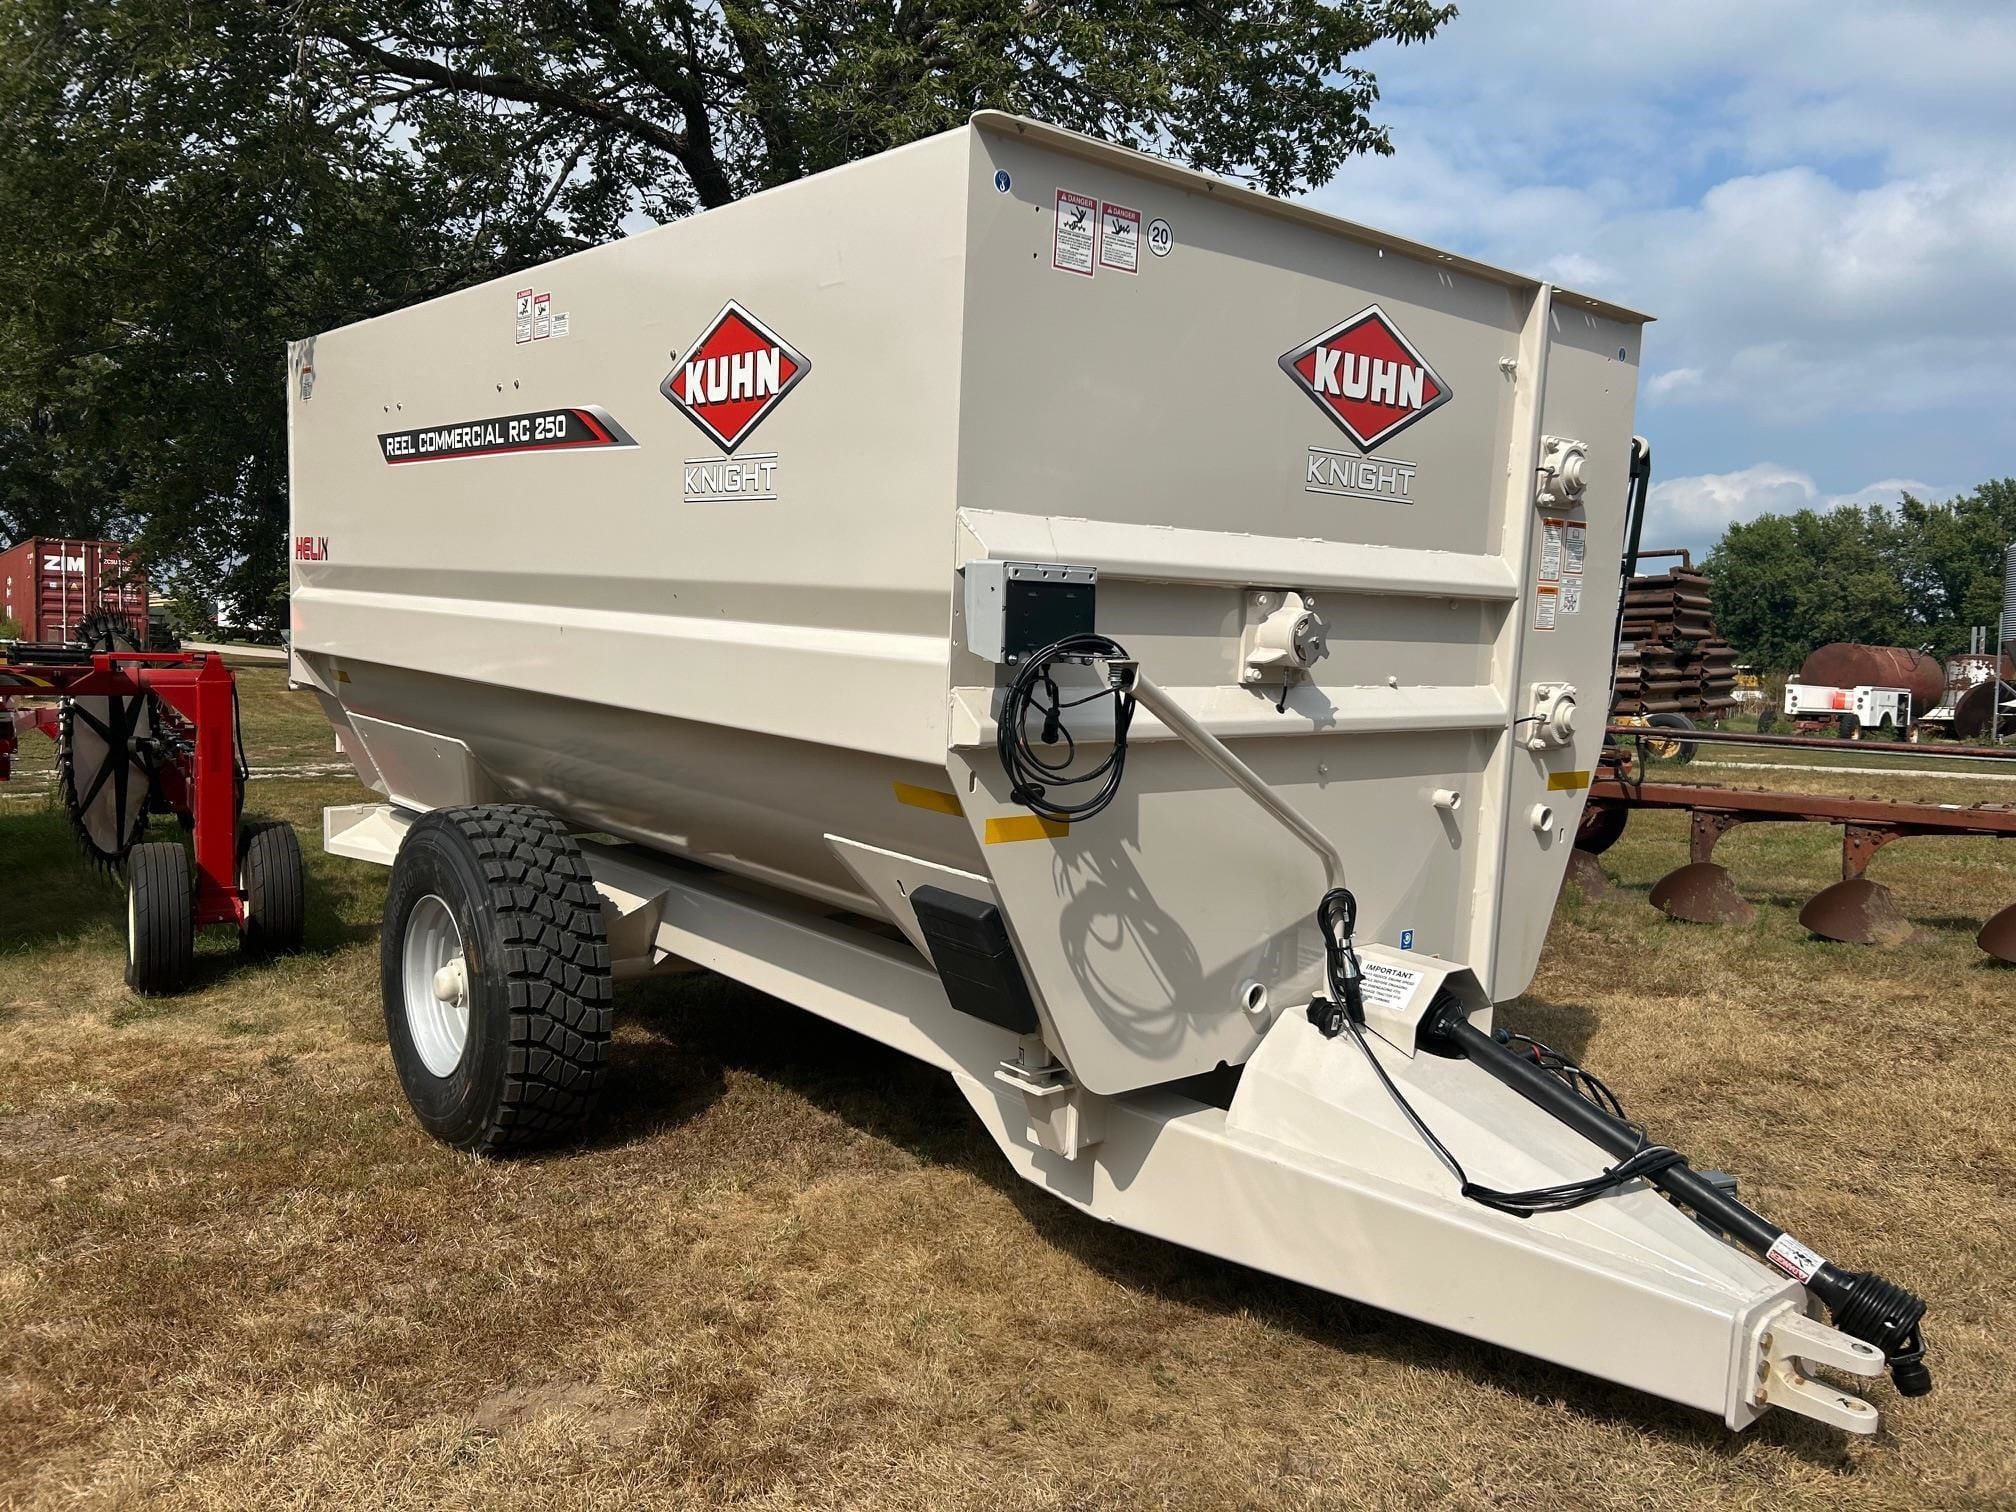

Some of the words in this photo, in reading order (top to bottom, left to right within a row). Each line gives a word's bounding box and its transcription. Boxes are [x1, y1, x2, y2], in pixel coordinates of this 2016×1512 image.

[1067, 194, 1093, 208] DANGER
[1113, 207, 1136, 220] DANGER
[1152, 227, 1168, 244] 20
[685, 347, 780, 406] KUHN
[1313, 346, 1424, 410] KUHN
[386, 436, 416, 456] REEL
[418, 425, 505, 452] COMMERCIAL
[509, 419, 530, 442] RC
[534, 414, 566, 440] 250
[684, 461, 777, 494] KNIGHT
[1306, 455, 1416, 495] KNIGHT
[295, 536, 329, 561] HELIX
[43, 554, 85, 571] ZIM
[1366, 963, 1414, 979] IMPORTANT
[1770, 1250, 1799, 1277] DANGER
